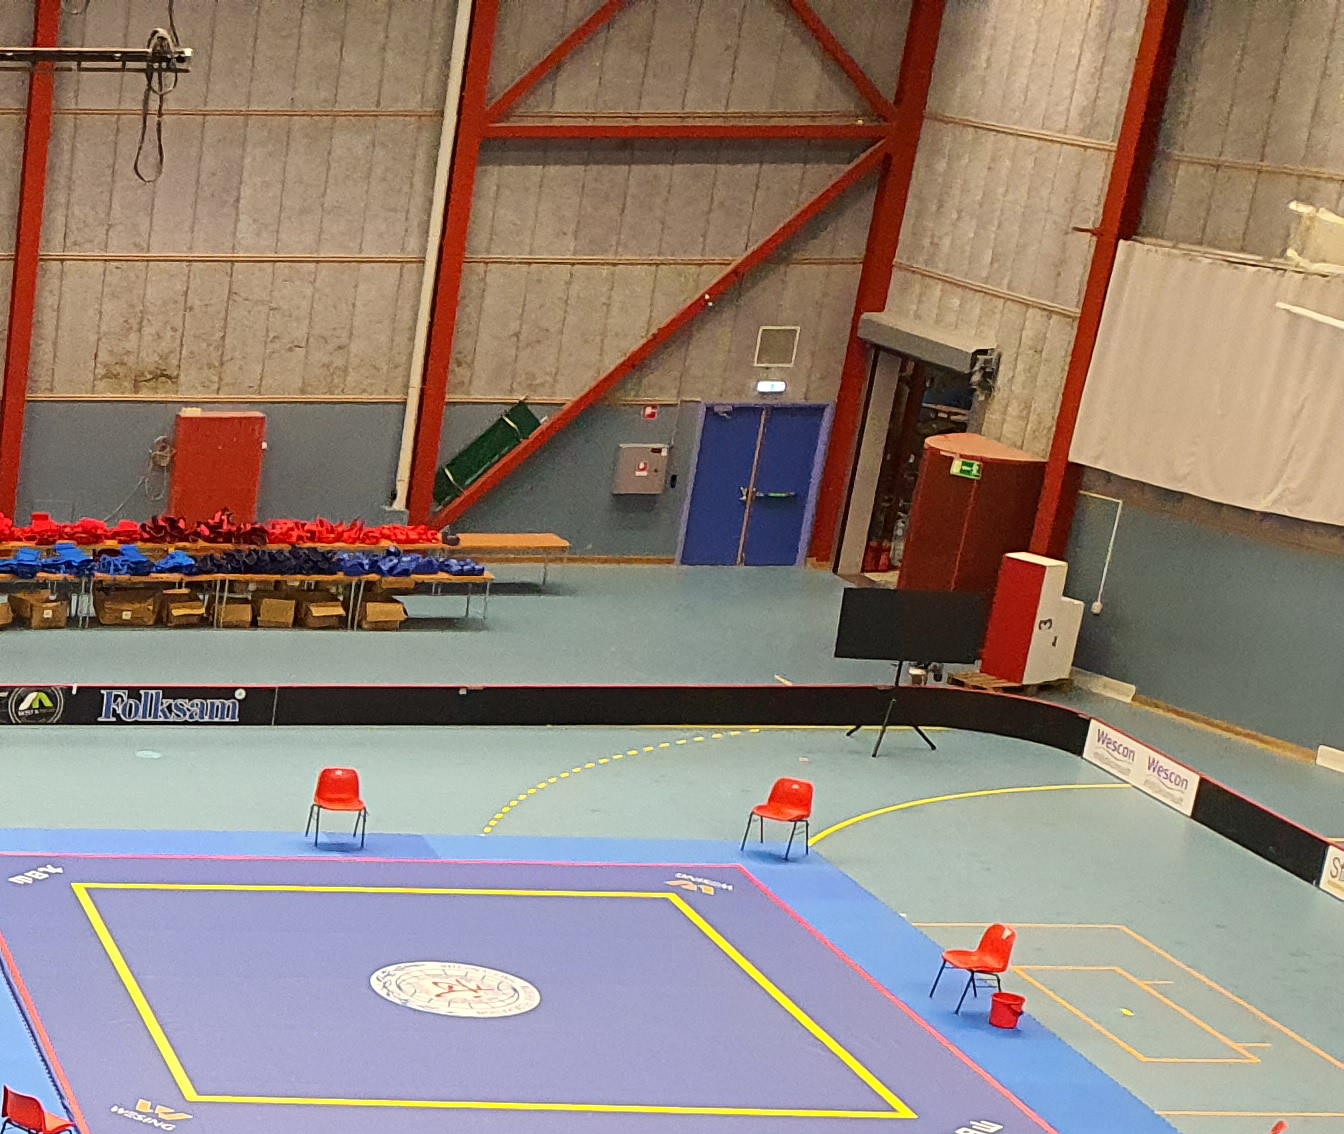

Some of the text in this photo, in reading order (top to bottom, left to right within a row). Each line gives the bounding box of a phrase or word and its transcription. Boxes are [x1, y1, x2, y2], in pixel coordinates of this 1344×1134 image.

[97, 689, 239, 722] Folksam
[1097, 728, 1135, 762] Wescon
[1147, 755, 1189, 791] Wescon
